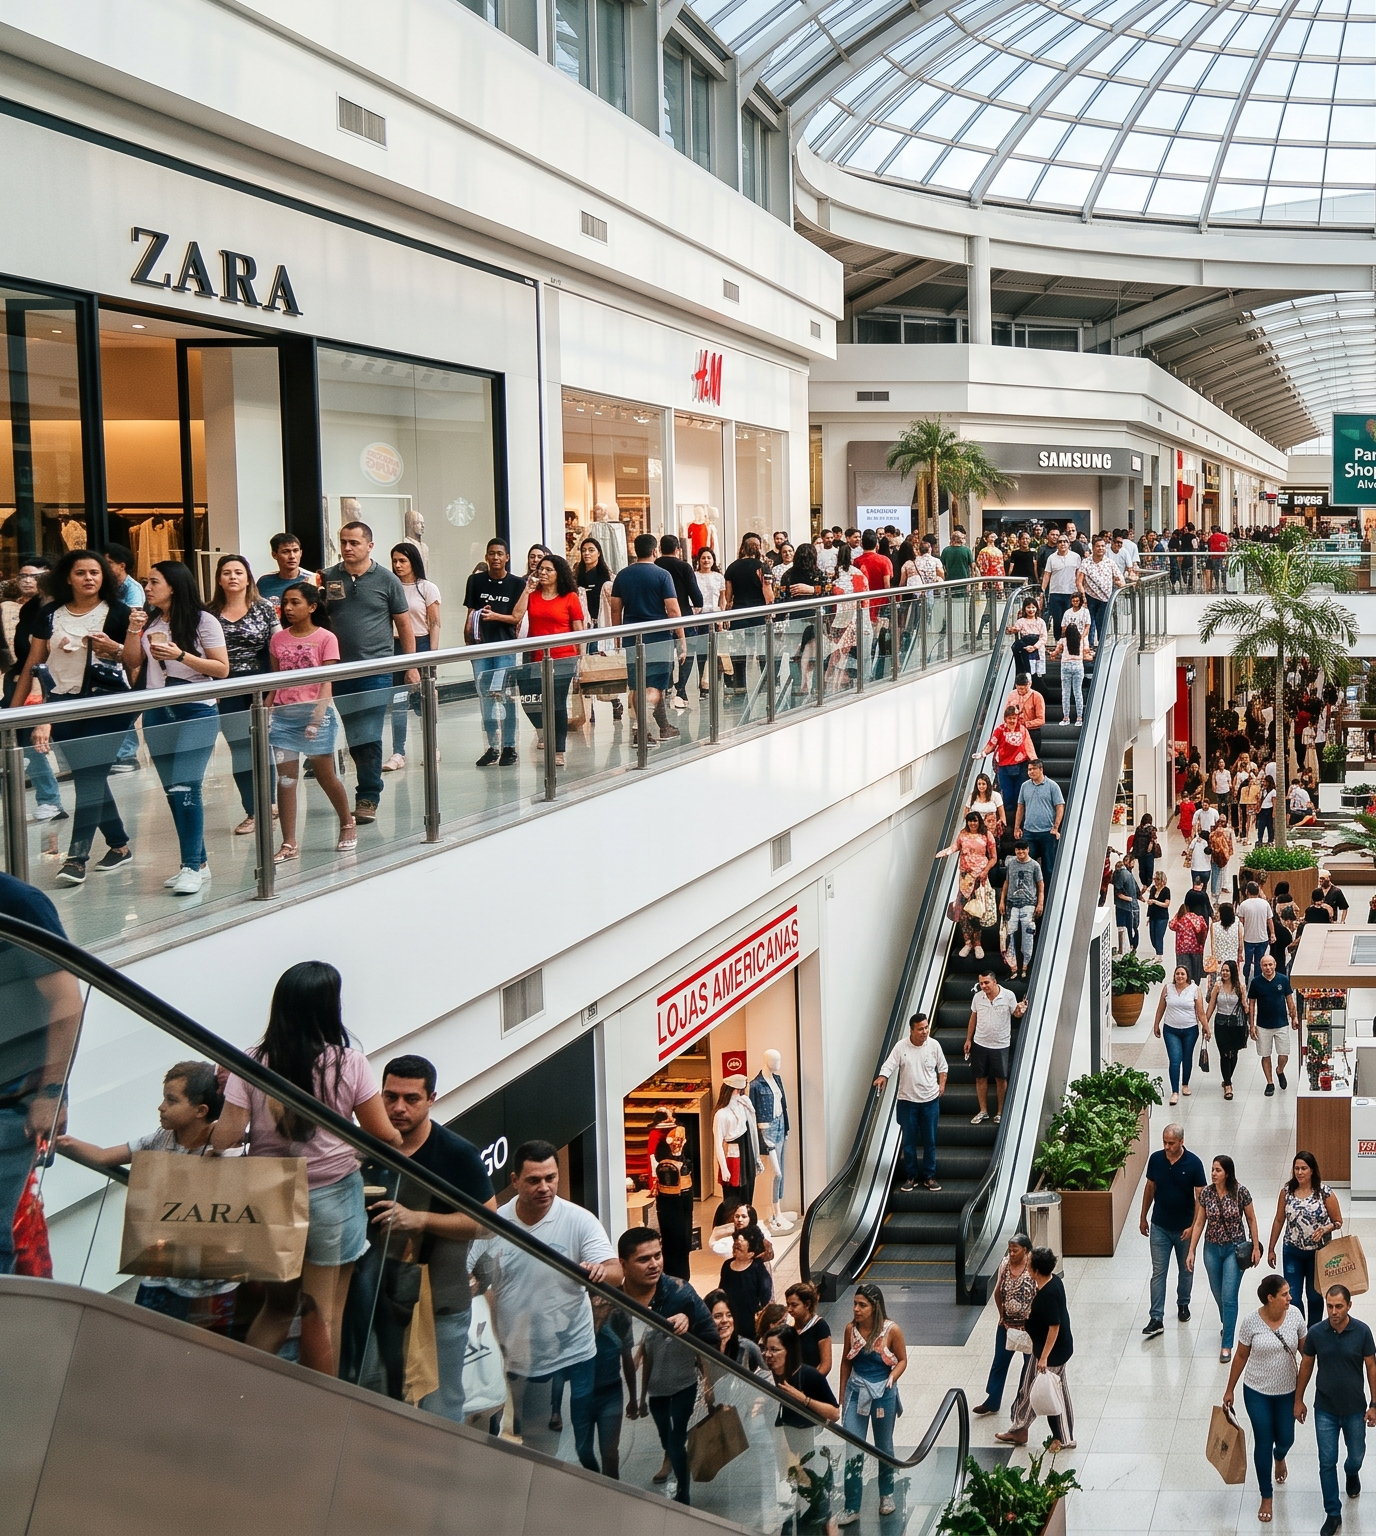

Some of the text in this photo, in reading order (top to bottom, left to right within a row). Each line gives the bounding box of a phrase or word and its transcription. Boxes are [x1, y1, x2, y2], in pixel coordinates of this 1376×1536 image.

[130, 227, 304, 317] ZARA
[1039, 451, 1112, 469] SAMSUNG
[657, 918, 799, 1046] LOJAS AMERICANAS
[160, 1202, 261, 1223] ZARA
